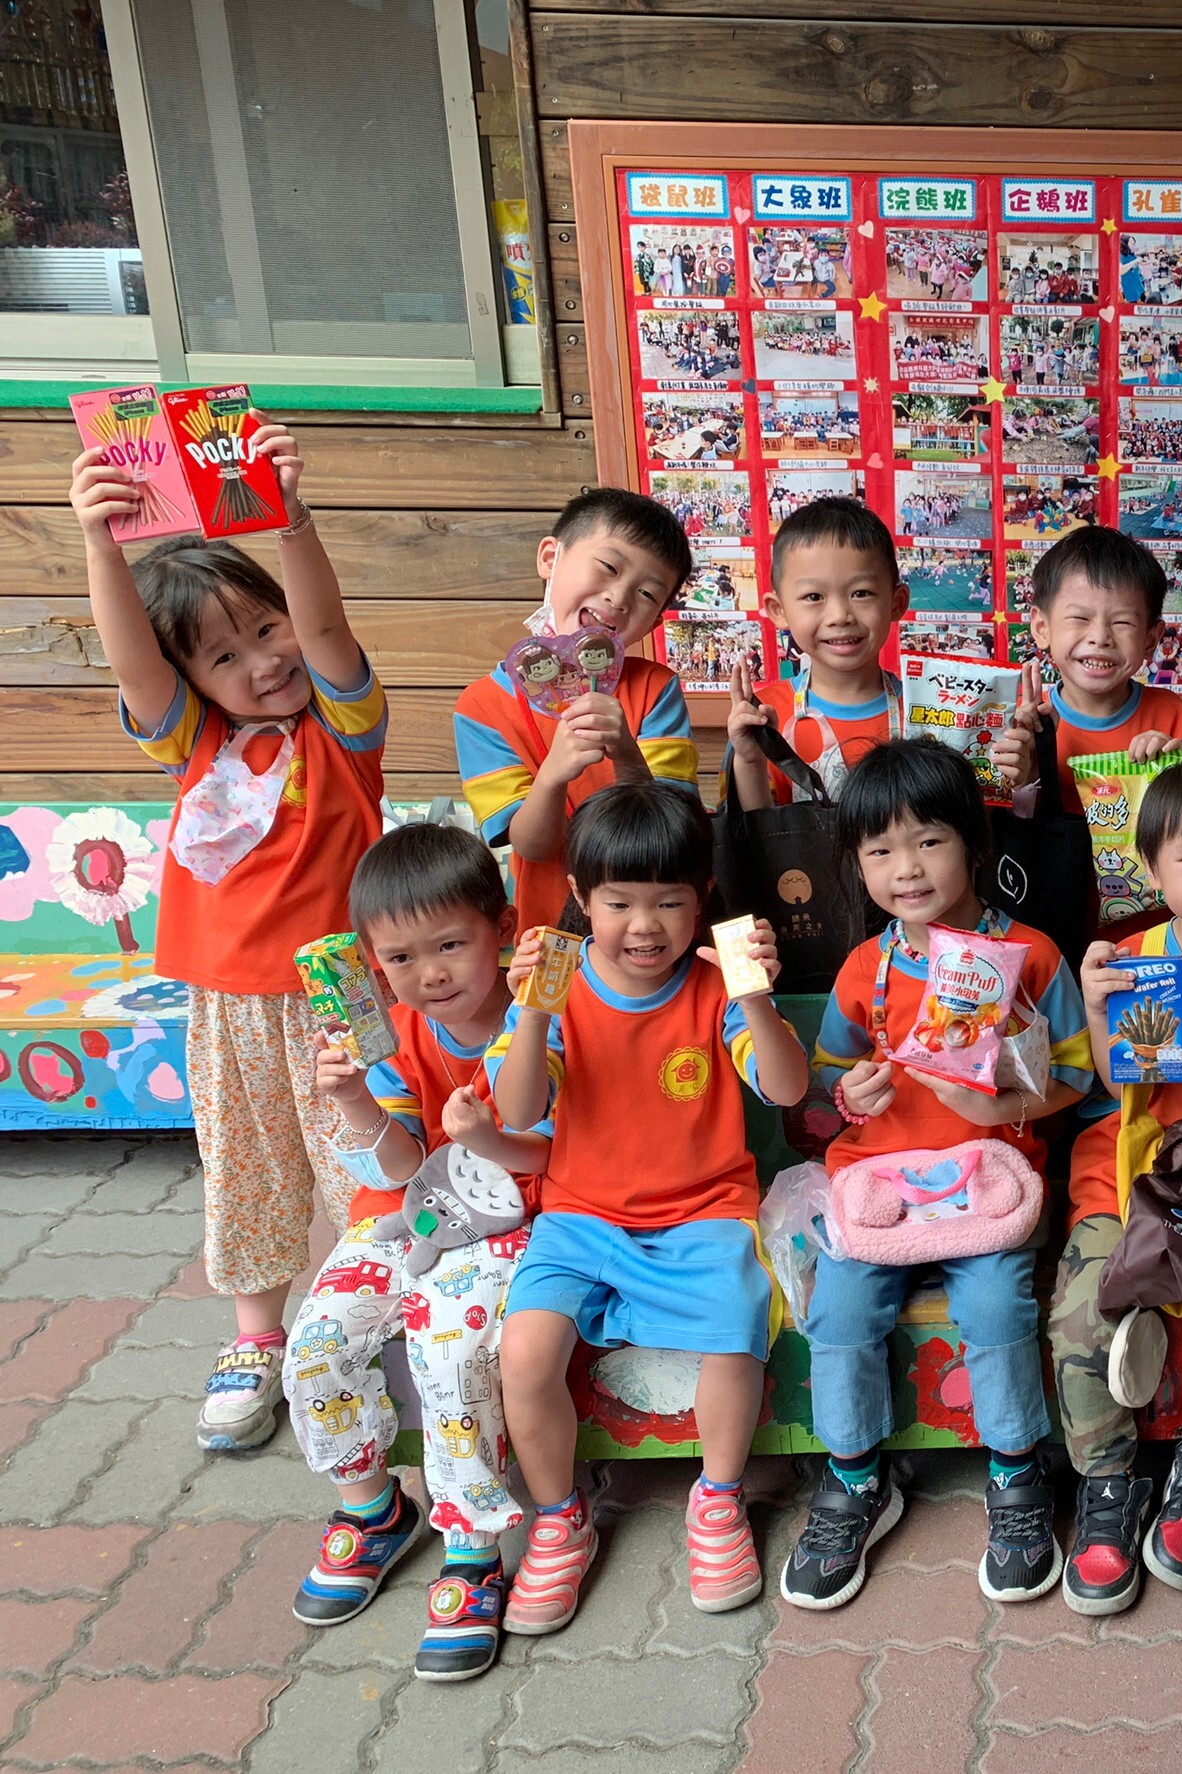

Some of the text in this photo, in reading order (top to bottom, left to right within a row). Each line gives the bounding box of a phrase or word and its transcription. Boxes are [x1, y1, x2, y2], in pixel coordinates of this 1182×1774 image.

[638, 183, 717, 209] 袋鼠班
[760, 185, 842, 210] 大象班
[886, 188, 968, 212] 浣熊班
[1008, 188, 1089, 213] 企鵝班
[928, 673, 994, 695] ベビースター
[937, 690, 980, 708] ラーメン
[937, 963, 1000, 993] Cream Puff
[1133, 980, 1159, 993] Wafer
